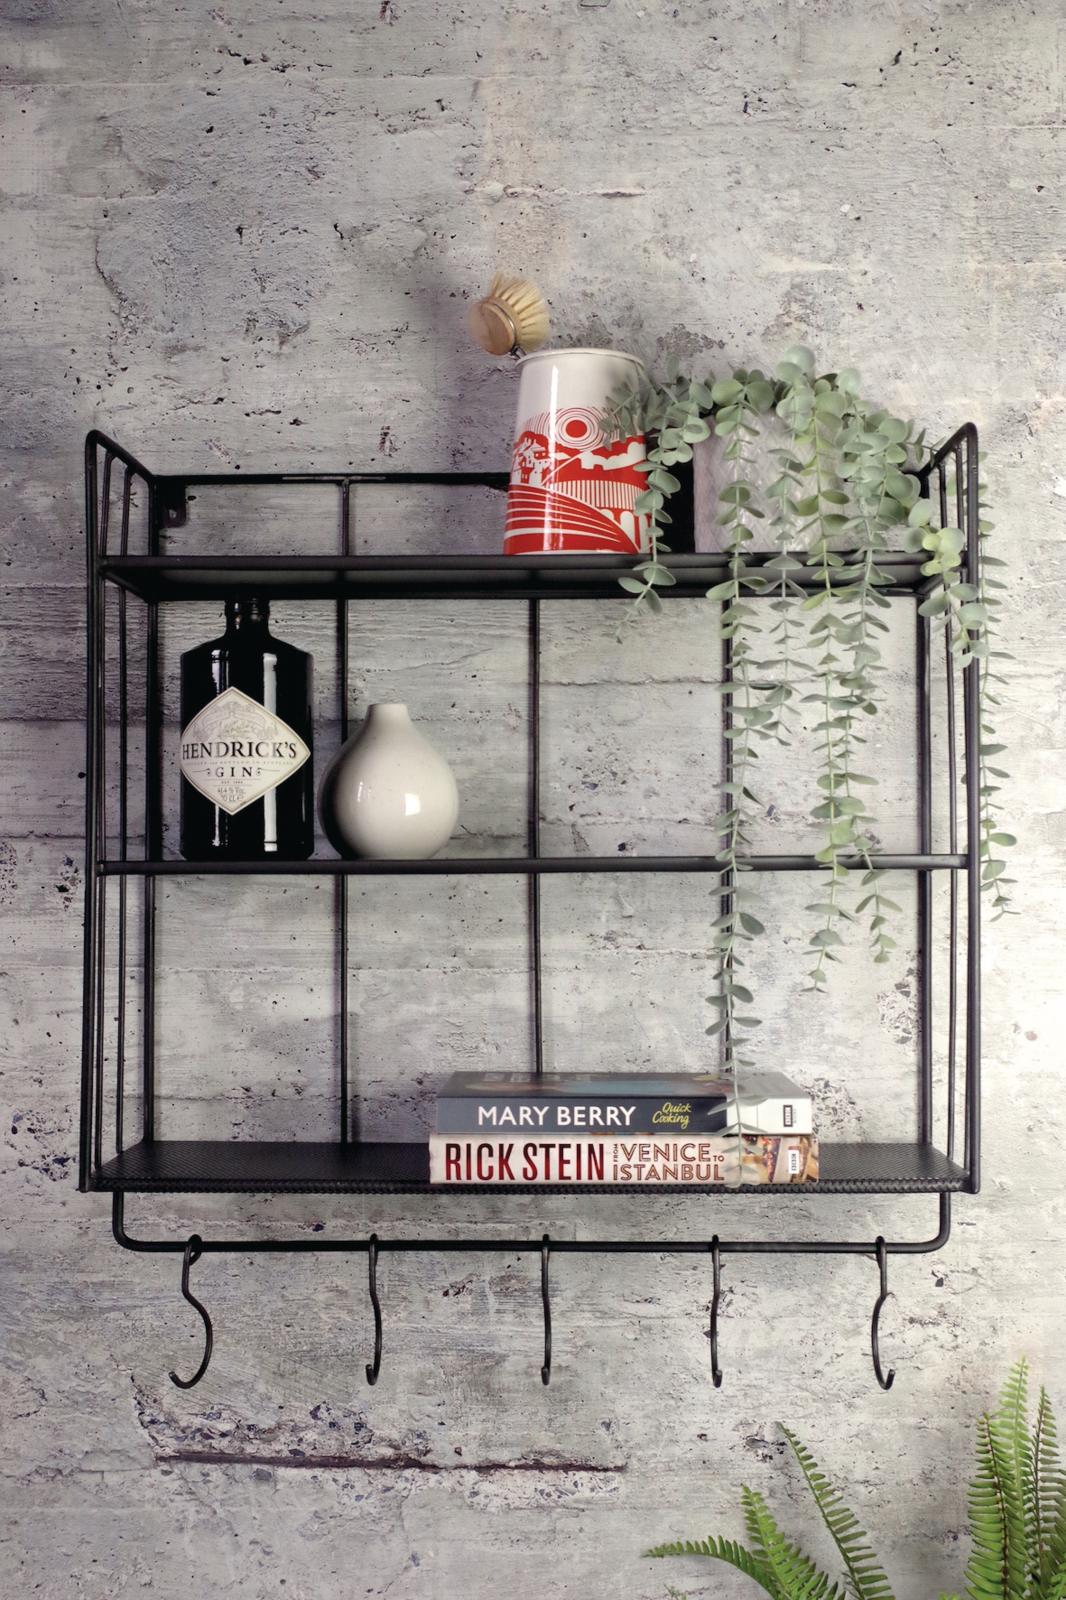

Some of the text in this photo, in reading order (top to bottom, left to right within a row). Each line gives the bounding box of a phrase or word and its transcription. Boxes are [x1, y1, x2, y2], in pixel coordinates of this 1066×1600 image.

[182, 741, 297, 760] HENDRICK'S
[215, 766, 252, 777] GIN
[478, 1106, 636, 1126] MARY BERRY
[662, 1102, 692, 1115] Quick
[652, 1110, 690, 1129] Cooking
[445, 1142, 604, 1180] RICK STEIN
[620, 1143, 711, 1162] VENICE
[613, 1163, 725, 1181] ISTANBUL
